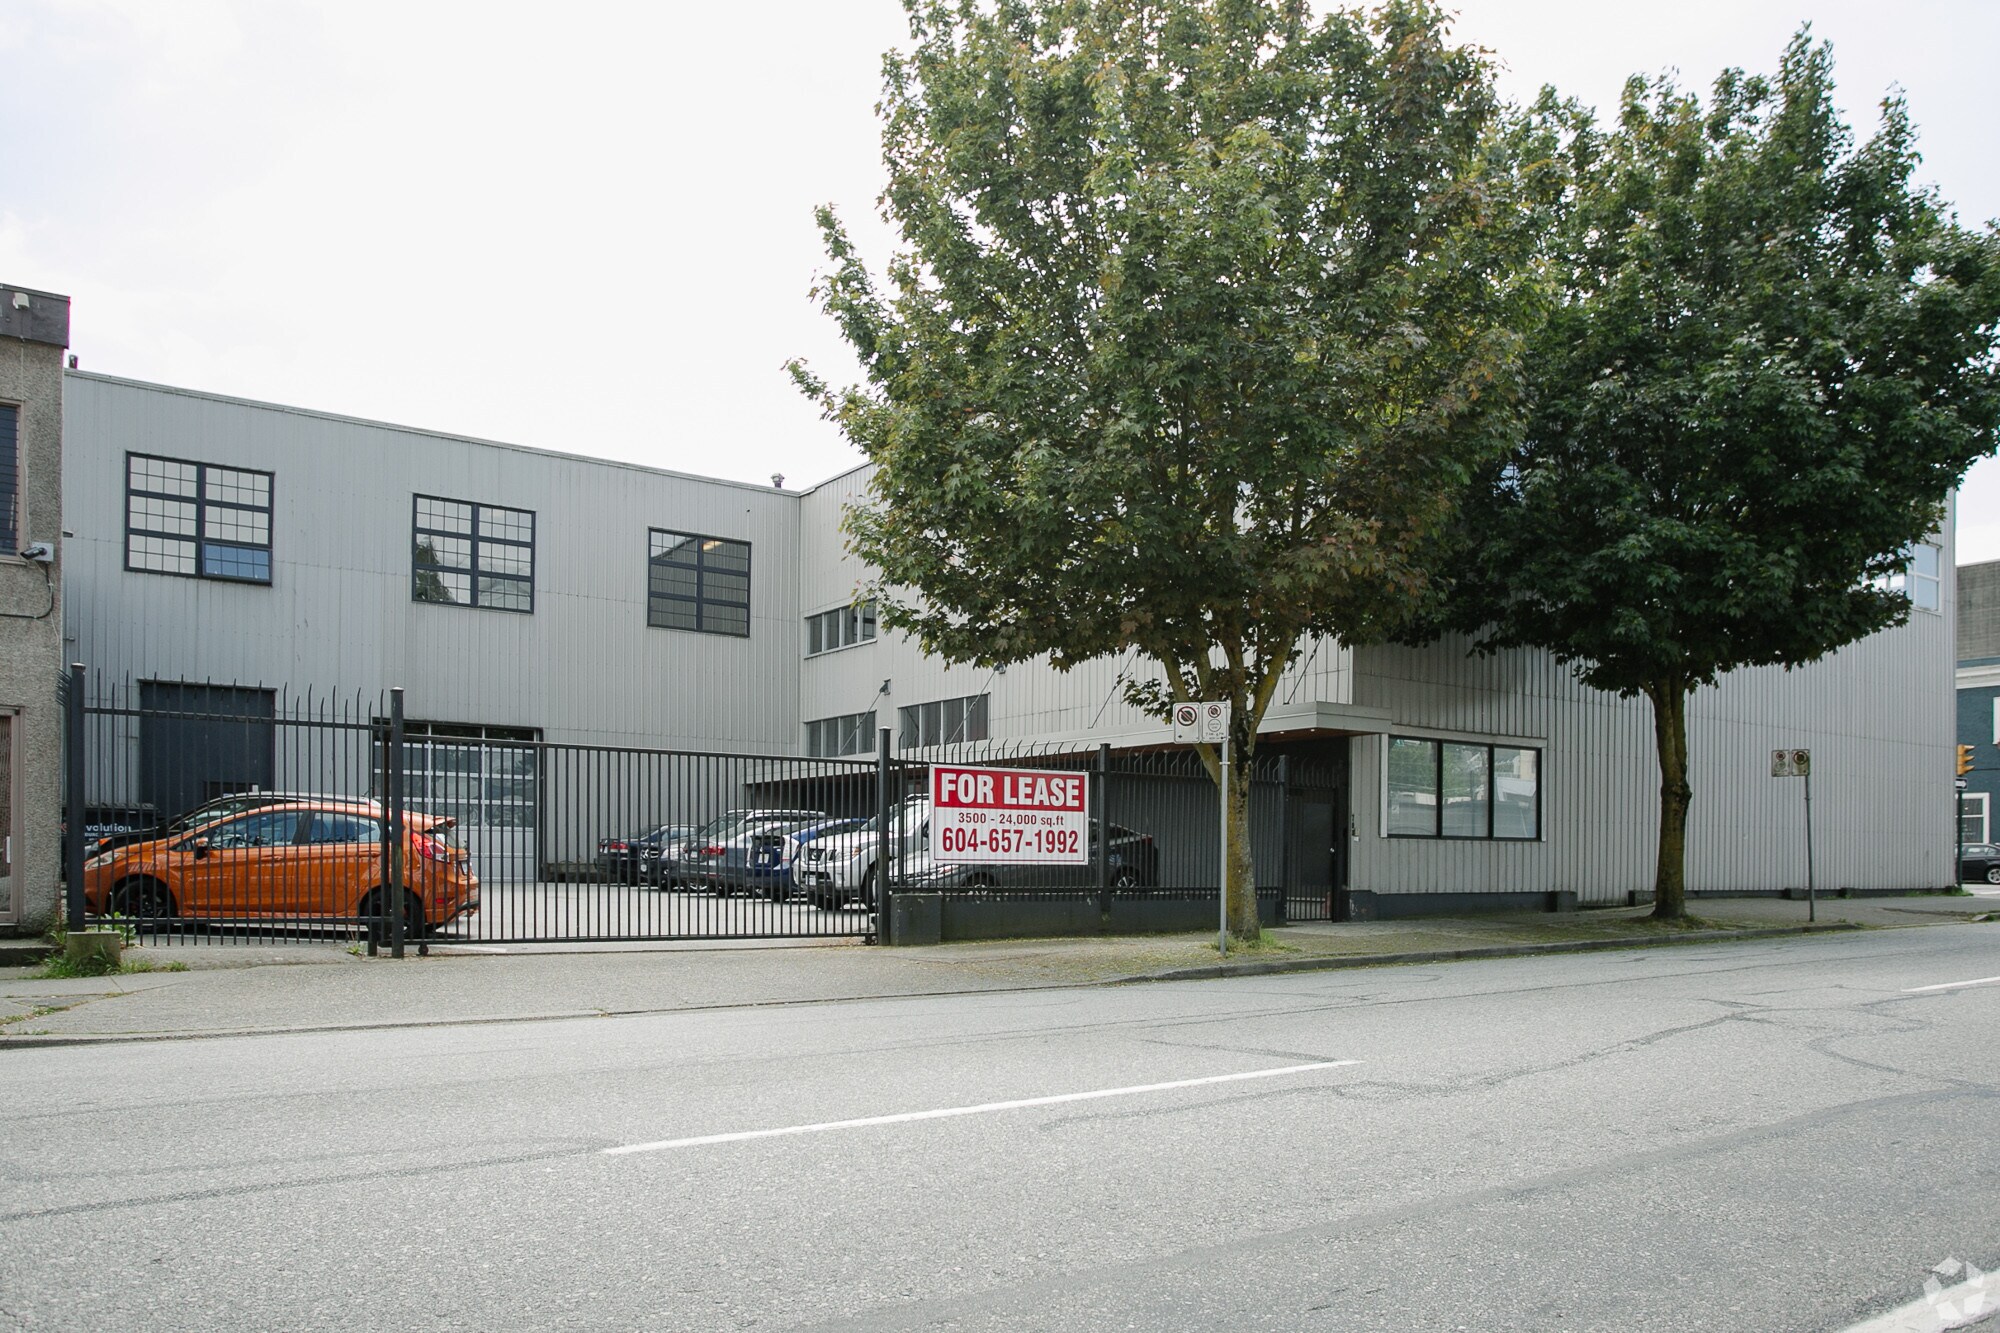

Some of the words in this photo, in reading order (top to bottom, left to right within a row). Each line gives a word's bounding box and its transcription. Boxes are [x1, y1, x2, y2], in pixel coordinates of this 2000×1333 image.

[940, 772, 995, 804] FOR
[1003, 775, 1080, 807] LEASE
[958, 812, 986, 824] 3500
[999, 813, 1037, 826] 24,000
[1040, 815, 1064, 827] sq.ft
[942, 827, 1079, 854] 604-657-1992
